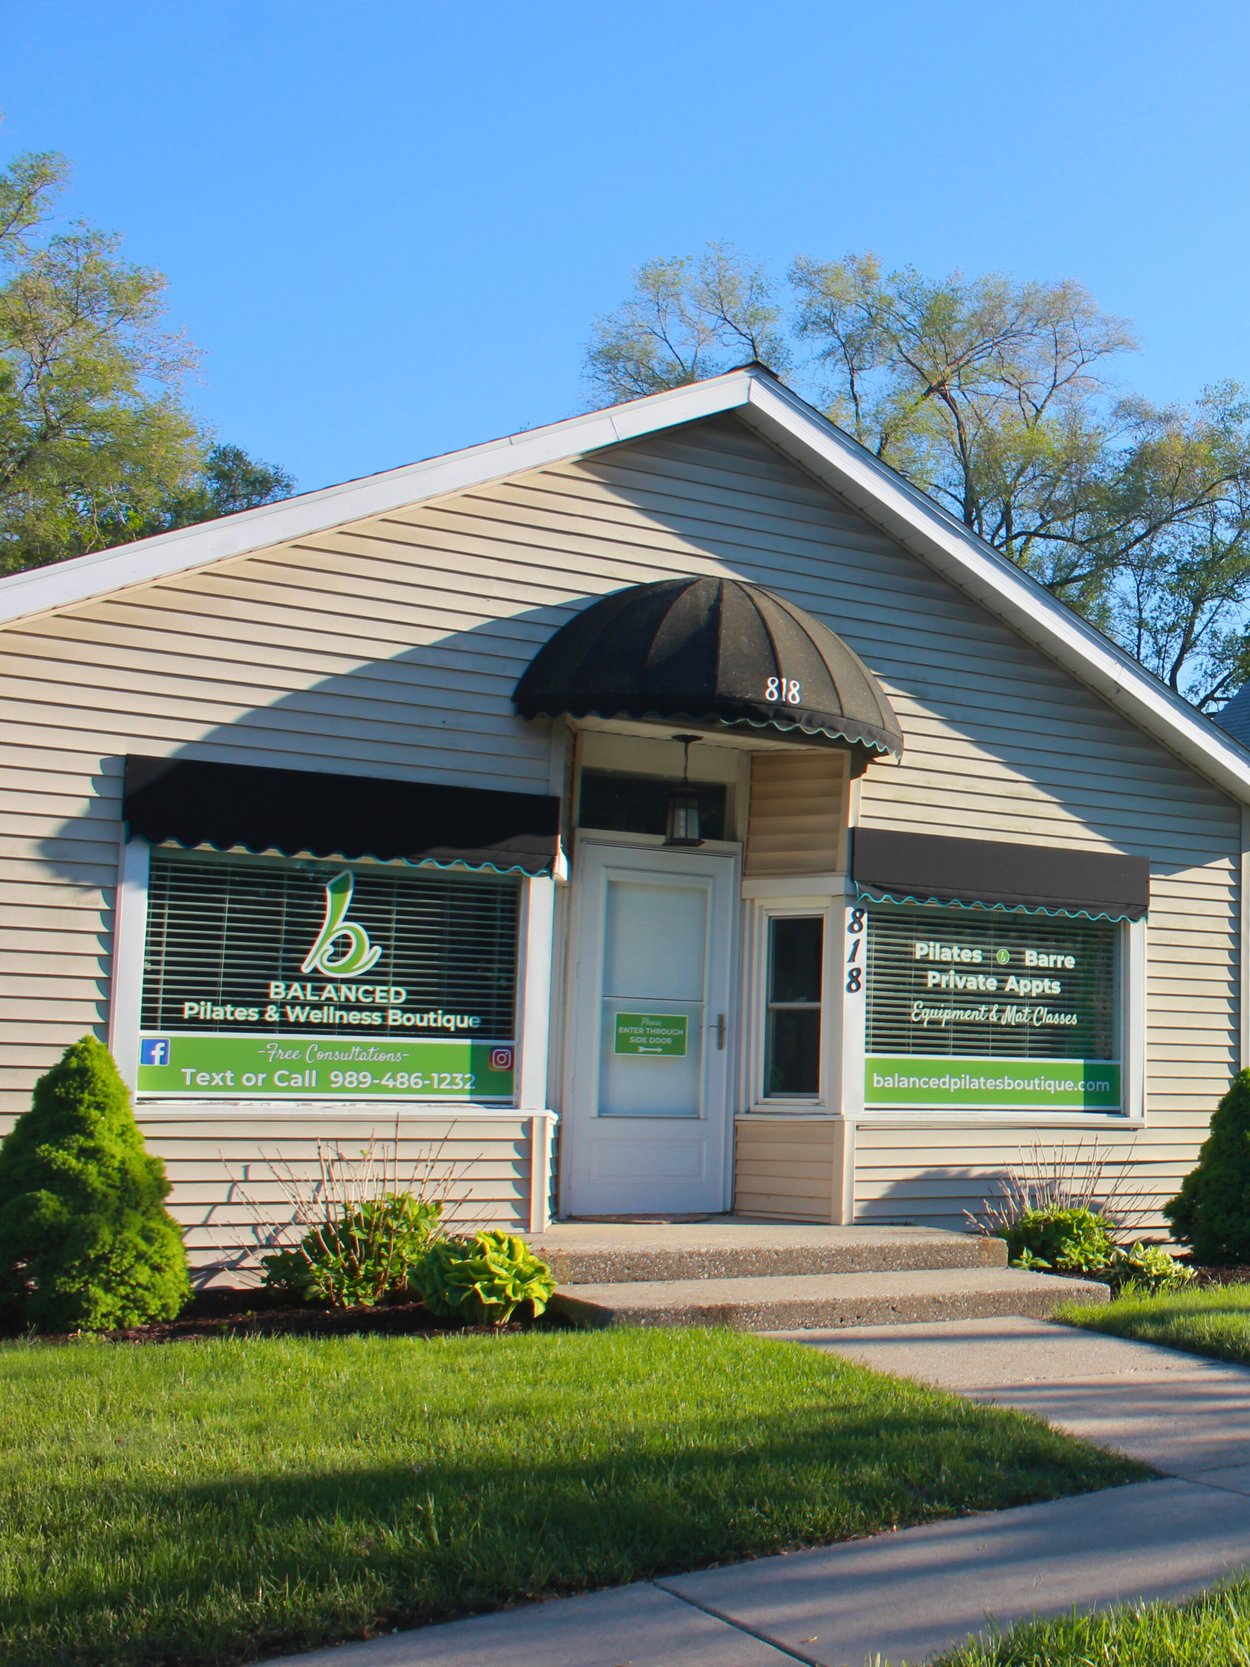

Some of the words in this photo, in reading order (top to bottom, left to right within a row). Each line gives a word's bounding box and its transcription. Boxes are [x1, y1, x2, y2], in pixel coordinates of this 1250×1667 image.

[765, 677, 800, 704] 818
[915, 943, 983, 963] Pilates
[1025, 950, 1076, 969] Barre
[269, 981, 407, 1005] BALANCED
[927, 970, 997, 991] Private
[1004, 975, 1061, 996] Appts
[183, 1001, 259, 1022] Pilates
[265, 1005, 280, 1022] &
[285, 1005, 382, 1026] Wellness
[388, 1009, 481, 1032] Boutique
[641, 1017, 662, 1026] Please
[911, 1001, 989, 1027] Equipment
[988, 1005, 999, 1021] &
[1001, 1005, 1031, 1025] Mat
[1033, 1006, 1078, 1027] Classes
[182, 1068, 235, 1087] Text
[242, 1071, 267, 1087] or
[273, 1069, 317, 1087] Call
[330, 1071, 476, 1090] 989-486-1232
[873, 1073, 1110, 1094] balancedpilatesboutique.com
